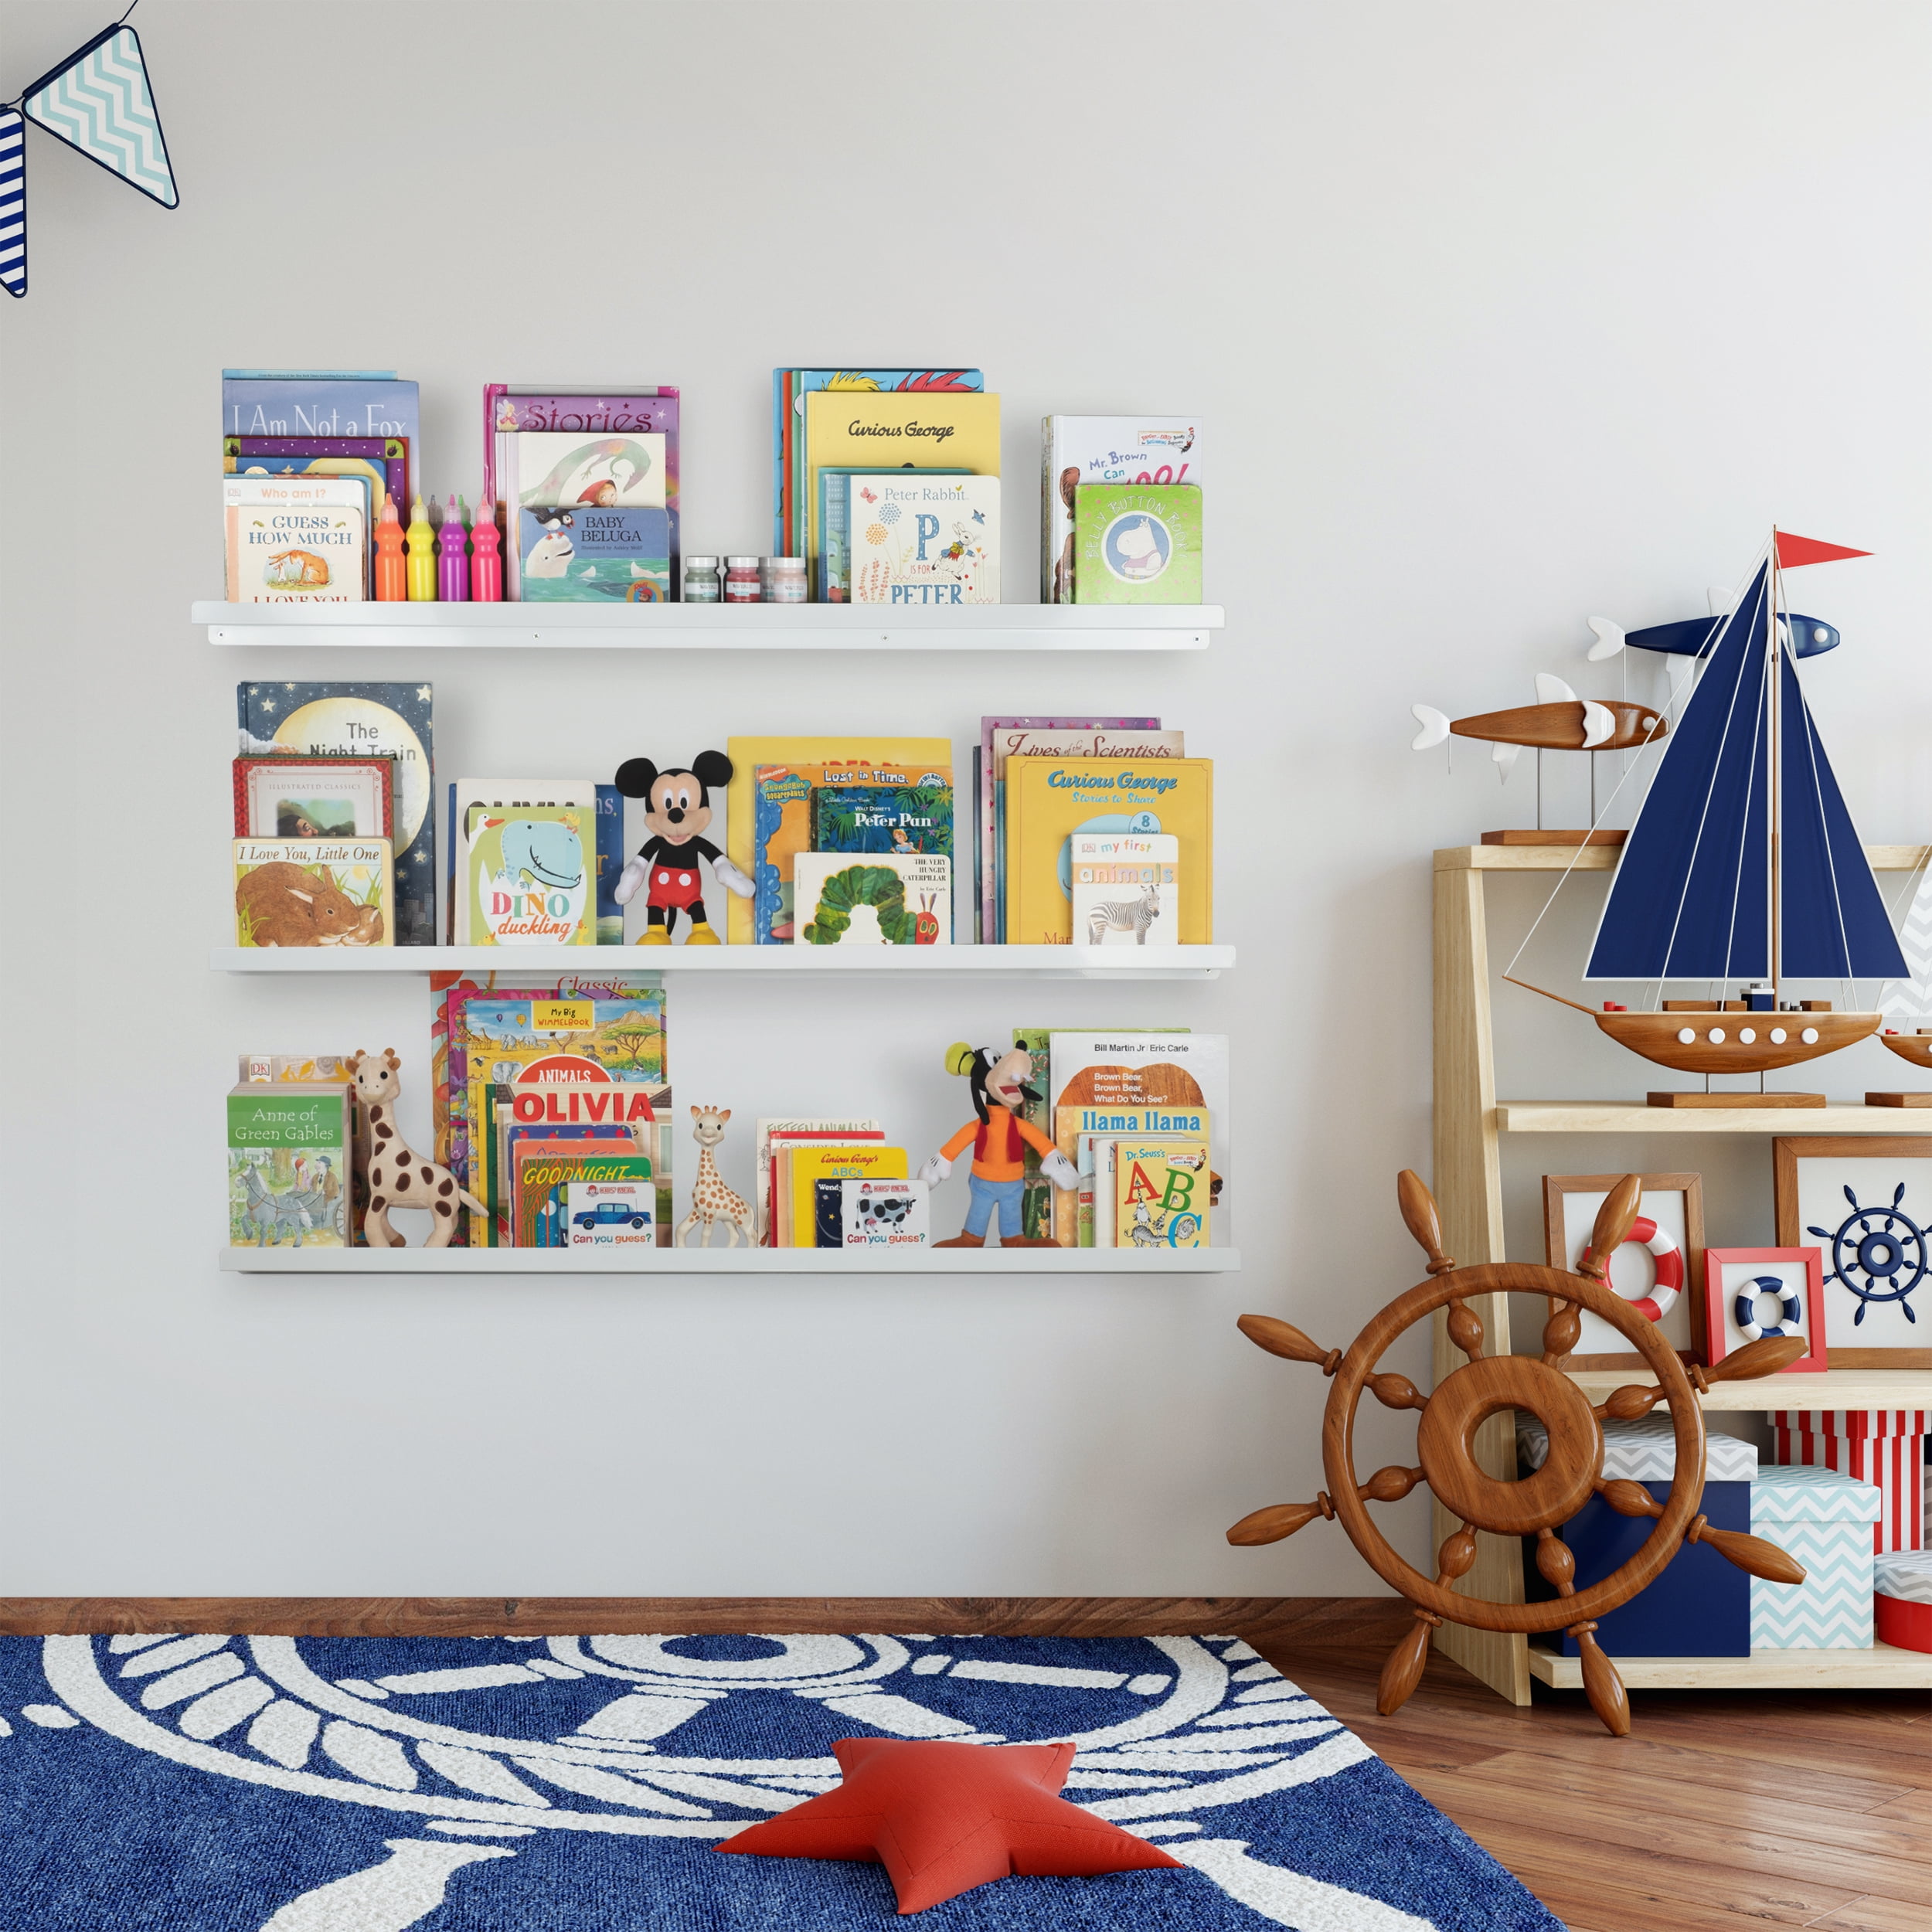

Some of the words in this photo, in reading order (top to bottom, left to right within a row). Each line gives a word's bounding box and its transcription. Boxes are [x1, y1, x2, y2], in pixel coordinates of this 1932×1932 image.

[232, 405, 240, 437] I
[250, 405, 287, 437] Am
[294, 405, 340, 437] Not
[346, 421, 358, 437] a
[365, 404, 406, 437] Fox
[522, 403, 653, 433] Stories
[848, 420, 903, 438] Curious
[904, 420, 954, 443] George
[1089, 457, 1107, 471] Mr.
[1107, 451, 1148, 465] Brown
[1104, 469, 1125, 480] Can
[260, 488, 288, 498] Who
[292, 489, 311, 498] am
[315, 488, 326, 498] I?
[885, 488, 920, 501] Peter
[922, 488, 966, 501] Rabbit
[272, 516, 329, 529] GUESS
[586, 516, 625, 529] BABY
[1086, 511, 1108, 561] BELLY
[1107, 495, 1167, 515] BUTTON
[248, 532, 291, 545] HOW
[298, 532, 352, 545] MUCH
[580, 530, 642, 542] BELUGA
[915, 514, 940, 561] P
[910, 565, 917, 574] IS
[917, 565, 930, 574] FOR
[891, 584, 964, 604] PETER
[346, 723, 379, 739] The
[1006, 733, 1060, 757] Lives
[1063, 743, 1072, 757] of
[1072, 740, 1083, 751] the
[1083, 736, 1172, 758] Scientists
[367, 744, 417, 761] Train
[824, 770, 854, 782] Lost
[859, 770, 869, 780] in
[1047, 770, 1114, 788] Curious
[1117, 771, 1179, 794] George
[1072, 792, 1108, 803] Stories
[1111, 793, 1122, 803] to
[1127, 793, 1156, 804] Share
[855, 813, 897, 828] Peter
[899, 813, 932, 828] Pan
[1142, 815, 1151, 828] 8
[1100, 842, 1120, 853] my
[1124, 839, 1151, 852] first
[239, 847, 247, 860] I
[250, 847, 280, 860] Love
[284, 847, 311, 862] You,
[315, 847, 349, 860] Little
[353, 847, 379, 860] One
[1080, 862, 1174, 883] animals
[490, 892, 570, 918] DINO
[498, 914, 572, 942] duckling
[551, 1008, 562, 1018] My
[563, 1008, 576, 1019] Big
[537, 1019, 590, 1028] WIMMELBOOK
[253, 1063, 268, 1073] DK
[539, 1070, 592, 1083] ANIMALS
[1122, 1073, 1143, 1082] Bear,
[1122, 1083, 1143, 1093] Bear,
[1094, 1094, 1115, 1103] What
[1117, 1094, 1128, 1103] Do
[1130, 1094, 1145, 1103] You
[1147, 1094, 1168, 1103] See?
[252, 1107, 296, 1122] Anne
[299, 1104, 319, 1121] of
[512, 1092, 655, 1122] OLIVIA
[1082, 1111, 1138, 1131] llama
[1145, 1111, 1201, 1131] llama
[235, 1126, 280, 1141] Green
[285, 1124, 334, 1141] Gables
[820, 1153, 849, 1163] Curious
[1125, 1151, 1138, 1161] Dr.
[1138, 1148, 1166, 1158] Seuss's
[523, 1165, 631, 1185] GOODNIGHT
[831, 1167, 863, 1177] ABCs
[573, 1234, 593, 1243] Can
[594, 1236, 613, 1244] you
[615, 1233, 652, 1244] guess?
[847, 1234, 866, 1243] Can
[868, 1236, 887, 1244] you
[889, 1233, 926, 1244] guess?
